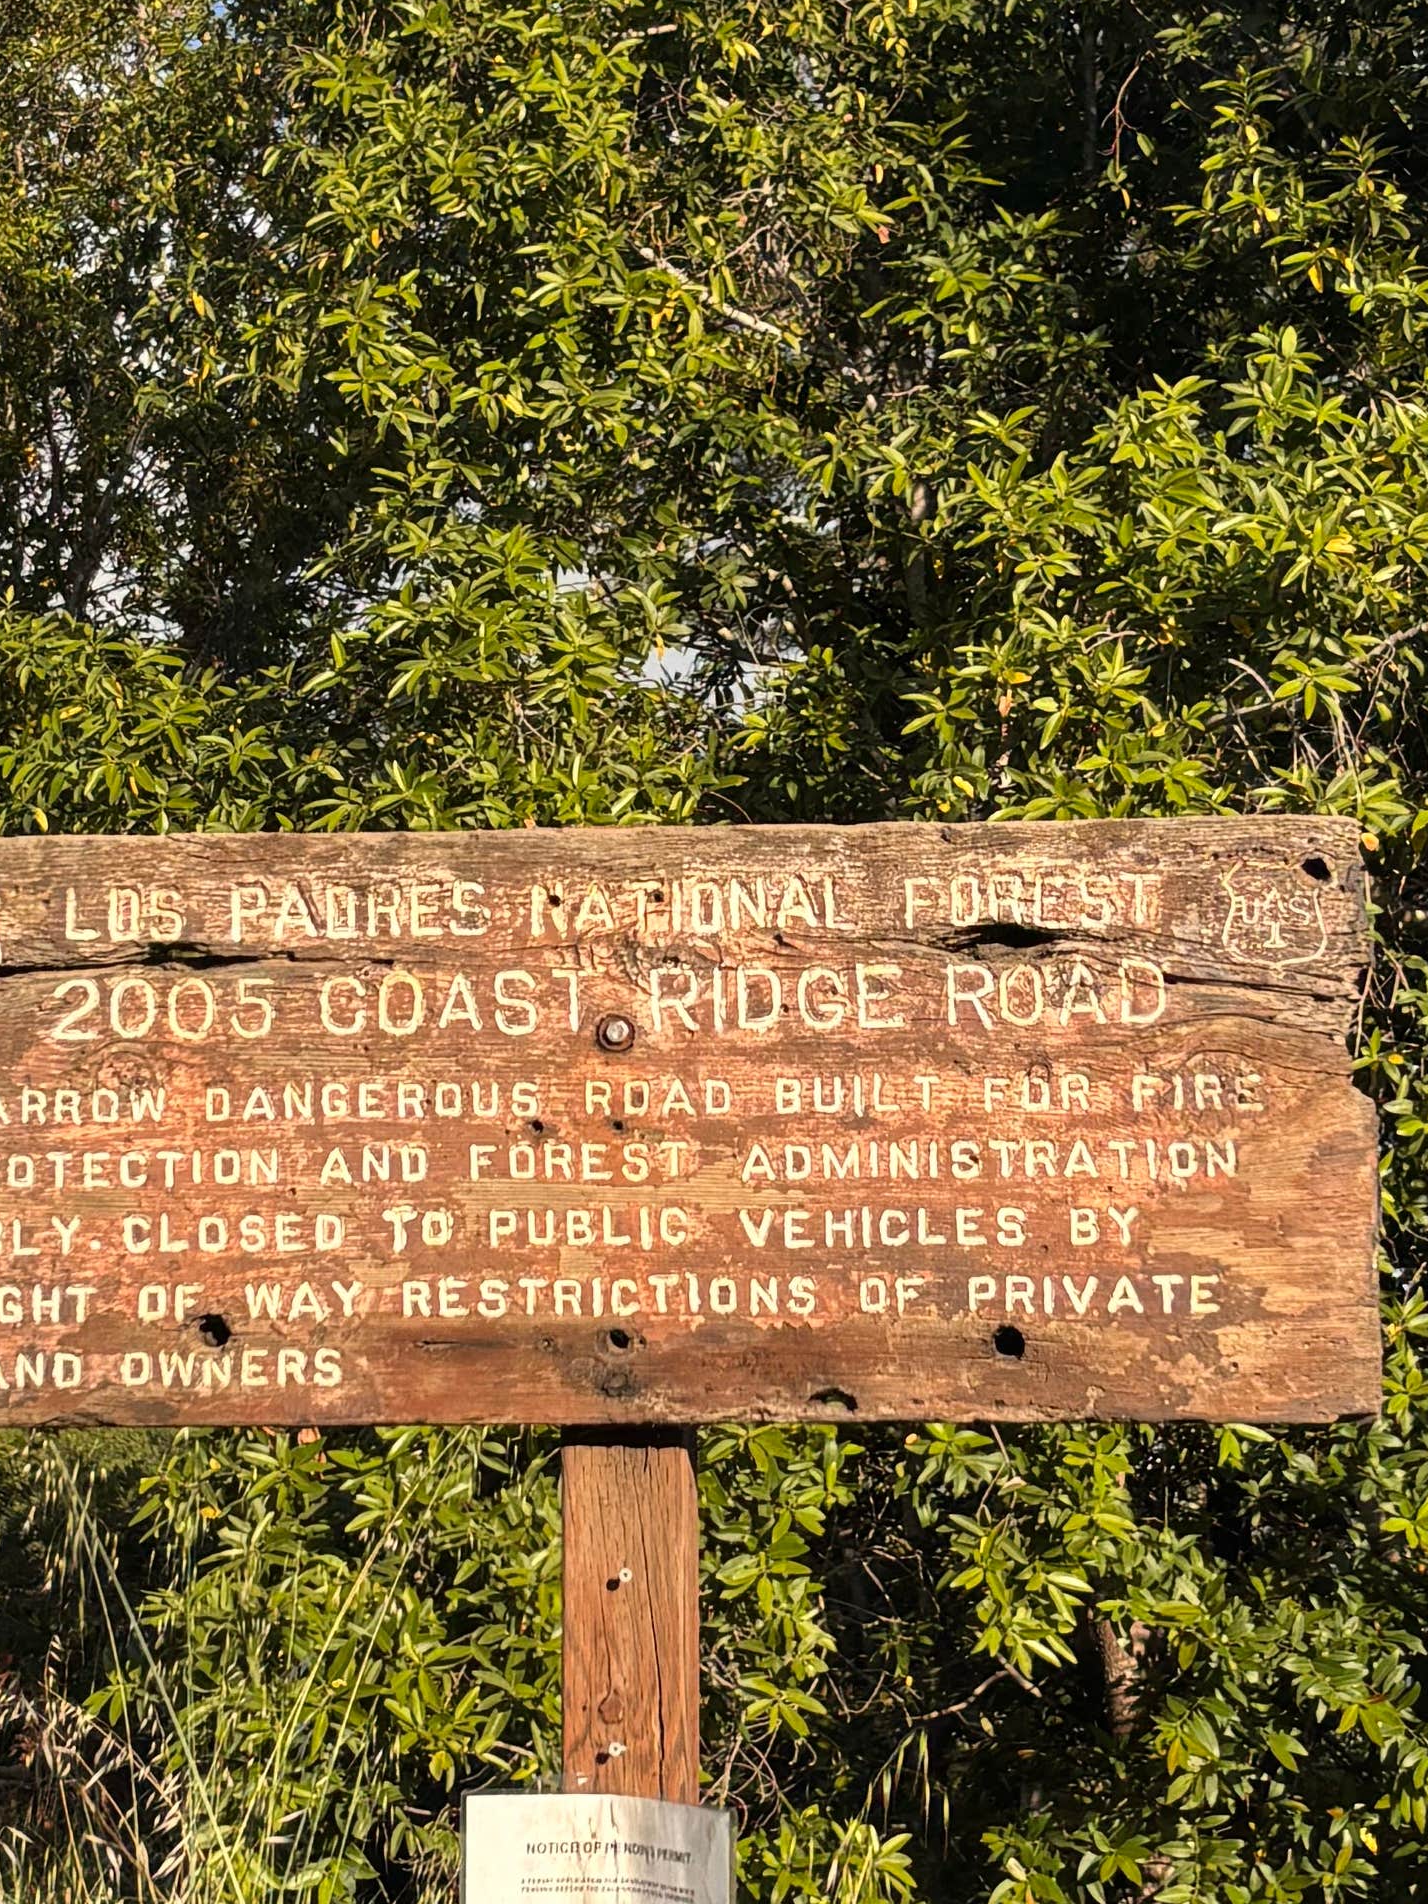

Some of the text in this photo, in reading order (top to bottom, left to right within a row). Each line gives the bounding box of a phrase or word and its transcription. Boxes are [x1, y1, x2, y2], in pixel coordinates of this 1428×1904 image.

[65, 872, 1160, 944] LOS PADRES NATIONAL FOREST
[50, 958, 1169, 1041] 2005 COAST RIDGE ROAD
[205, 1081, 540, 1123] DANGEROUS
[585, 1078, 732, 1117] ROAD
[774, 1074, 940, 1118] BUILT
[983, 1074, 1091, 1113] FOR
[1131, 1073, 1265, 1112] FIRE
[319, 1144, 428, 1186] AND
[469, 1141, 689, 1182] FOREST
[740, 1139, 1238, 1182] ADMINISTRATION
[122, 1213, 346, 1254] CLOSED
[382, 1204, 454, 1253] TO
[489, 1205, 689, 1250] PUBLIC
[738, 1206, 1027, 1250] VEHICLES
[1070, 1206, 1139, 1247] BY
[137, 1283, 206, 1323] OF
[243, 1280, 364, 1322] WAY
[401, 1272, 818, 1318] RESTRICTIONS
[859, 1276, 925, 1316] OF
[967, 1274, 1221, 1316] PRIVATE
[120, 1347, 343, 1389] OWNERS
